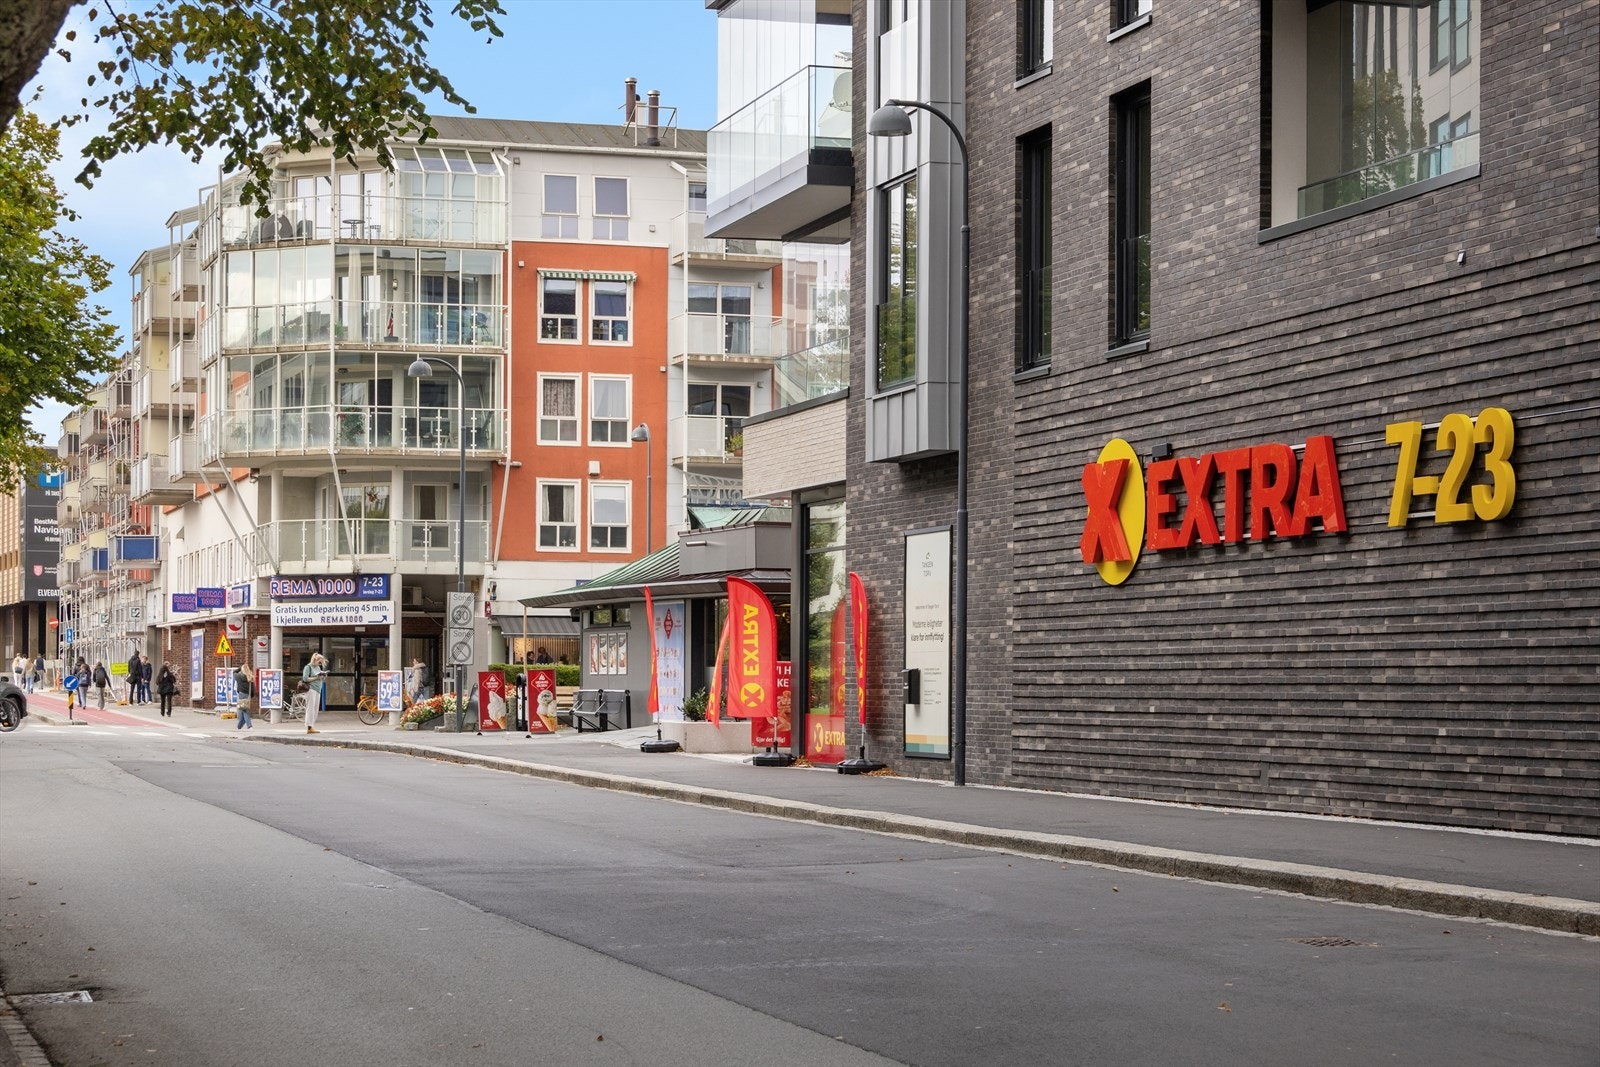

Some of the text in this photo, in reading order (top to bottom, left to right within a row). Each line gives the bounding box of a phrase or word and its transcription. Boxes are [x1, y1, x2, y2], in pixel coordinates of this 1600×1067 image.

[1385, 407, 1516, 527] 7-23
[1146, 435, 1348, 551] EXTRA
[269, 579, 317, 596] REMA
[319, 578, 356, 596] 1000
[363, 576, 383, 587] 7-23
[275, 603, 389, 615] Gratis kundeparkering 45 min.
[456, 610, 469, 621] 30
[280, 616, 313, 626] kjelleren
[320, 616, 343, 624] REMA
[345, 615, 363, 623] 1000
[262, 680, 273, 697] 59
[381, 681, 392, 699] 59
[825, 731, 845, 746] EXTRA
